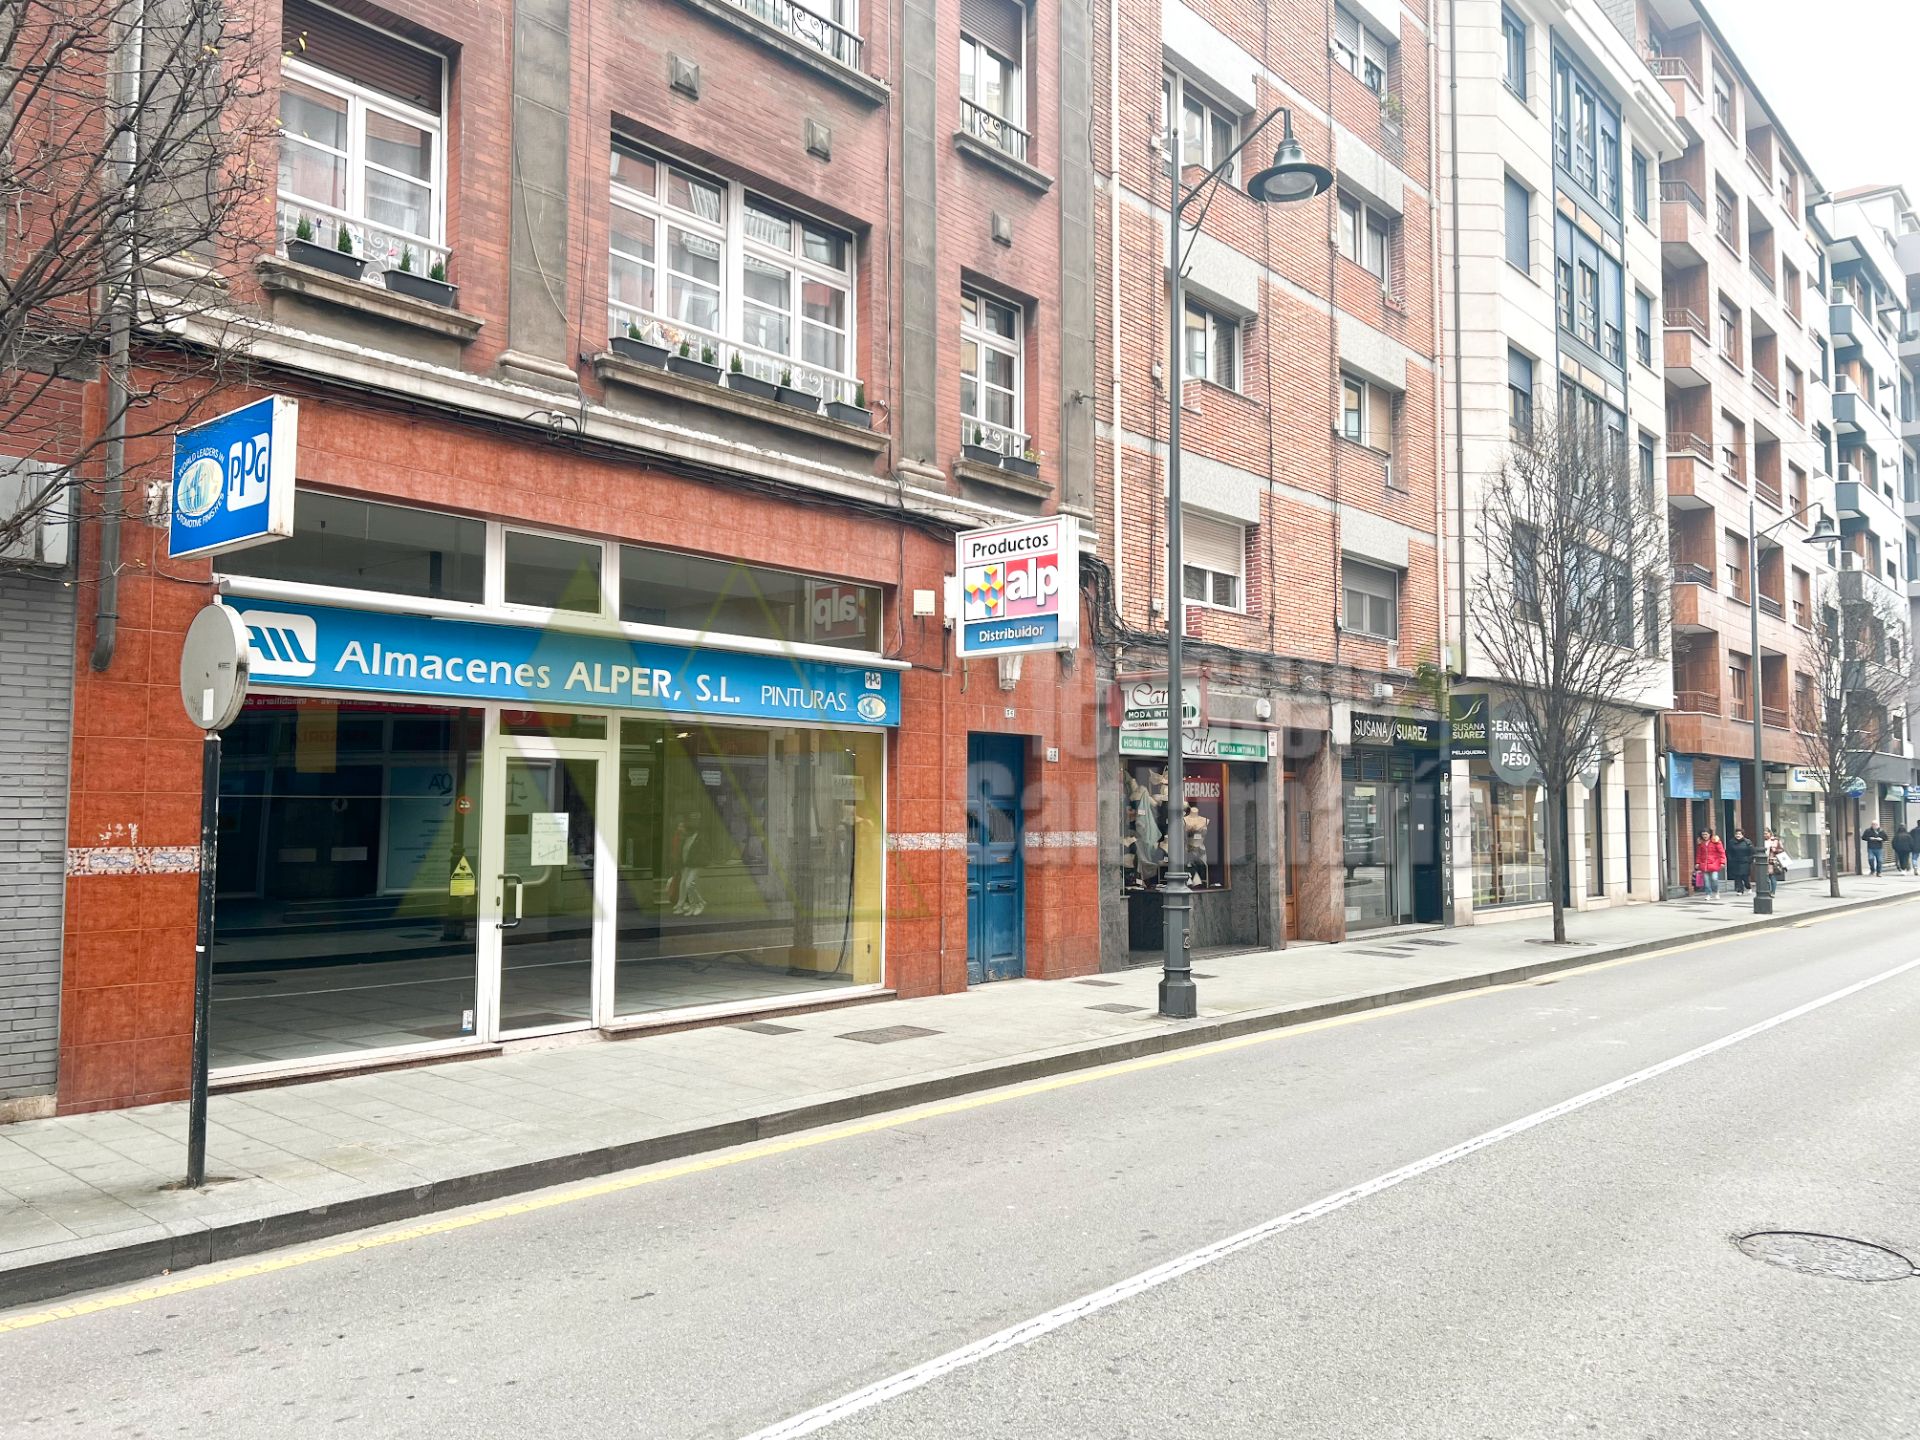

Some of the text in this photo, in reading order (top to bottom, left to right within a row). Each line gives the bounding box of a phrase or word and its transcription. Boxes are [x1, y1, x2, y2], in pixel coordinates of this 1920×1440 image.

[178, 452, 196, 477] WORLD
[195, 447, 219, 459] LEADERS
[229, 438, 267, 497] PPG
[972, 534, 1049, 558] Productos
[1006, 557, 1059, 606] alp
[979, 625, 1045, 643] Distribuidor
[333, 640, 551, 688] Almacenes
[563, 661, 682, 702] ALPER,
[696, 674, 741, 704] S.L.
[761, 685, 848, 712] PINTURAS
[1128, 710, 1151, 719] MODA
[1354, 719, 1428, 742] SUSANA SUAREZ
[1452, 723, 1486, 731] SUSANA
[1123, 739, 1151, 748] HOMBRE
[1510, 742, 1522, 753] AL
[1501, 753, 1531, 766] PESO
[1184, 782, 1220, 798] REBAXES
[1443, 772, 1453, 906] PELUQUERIA
